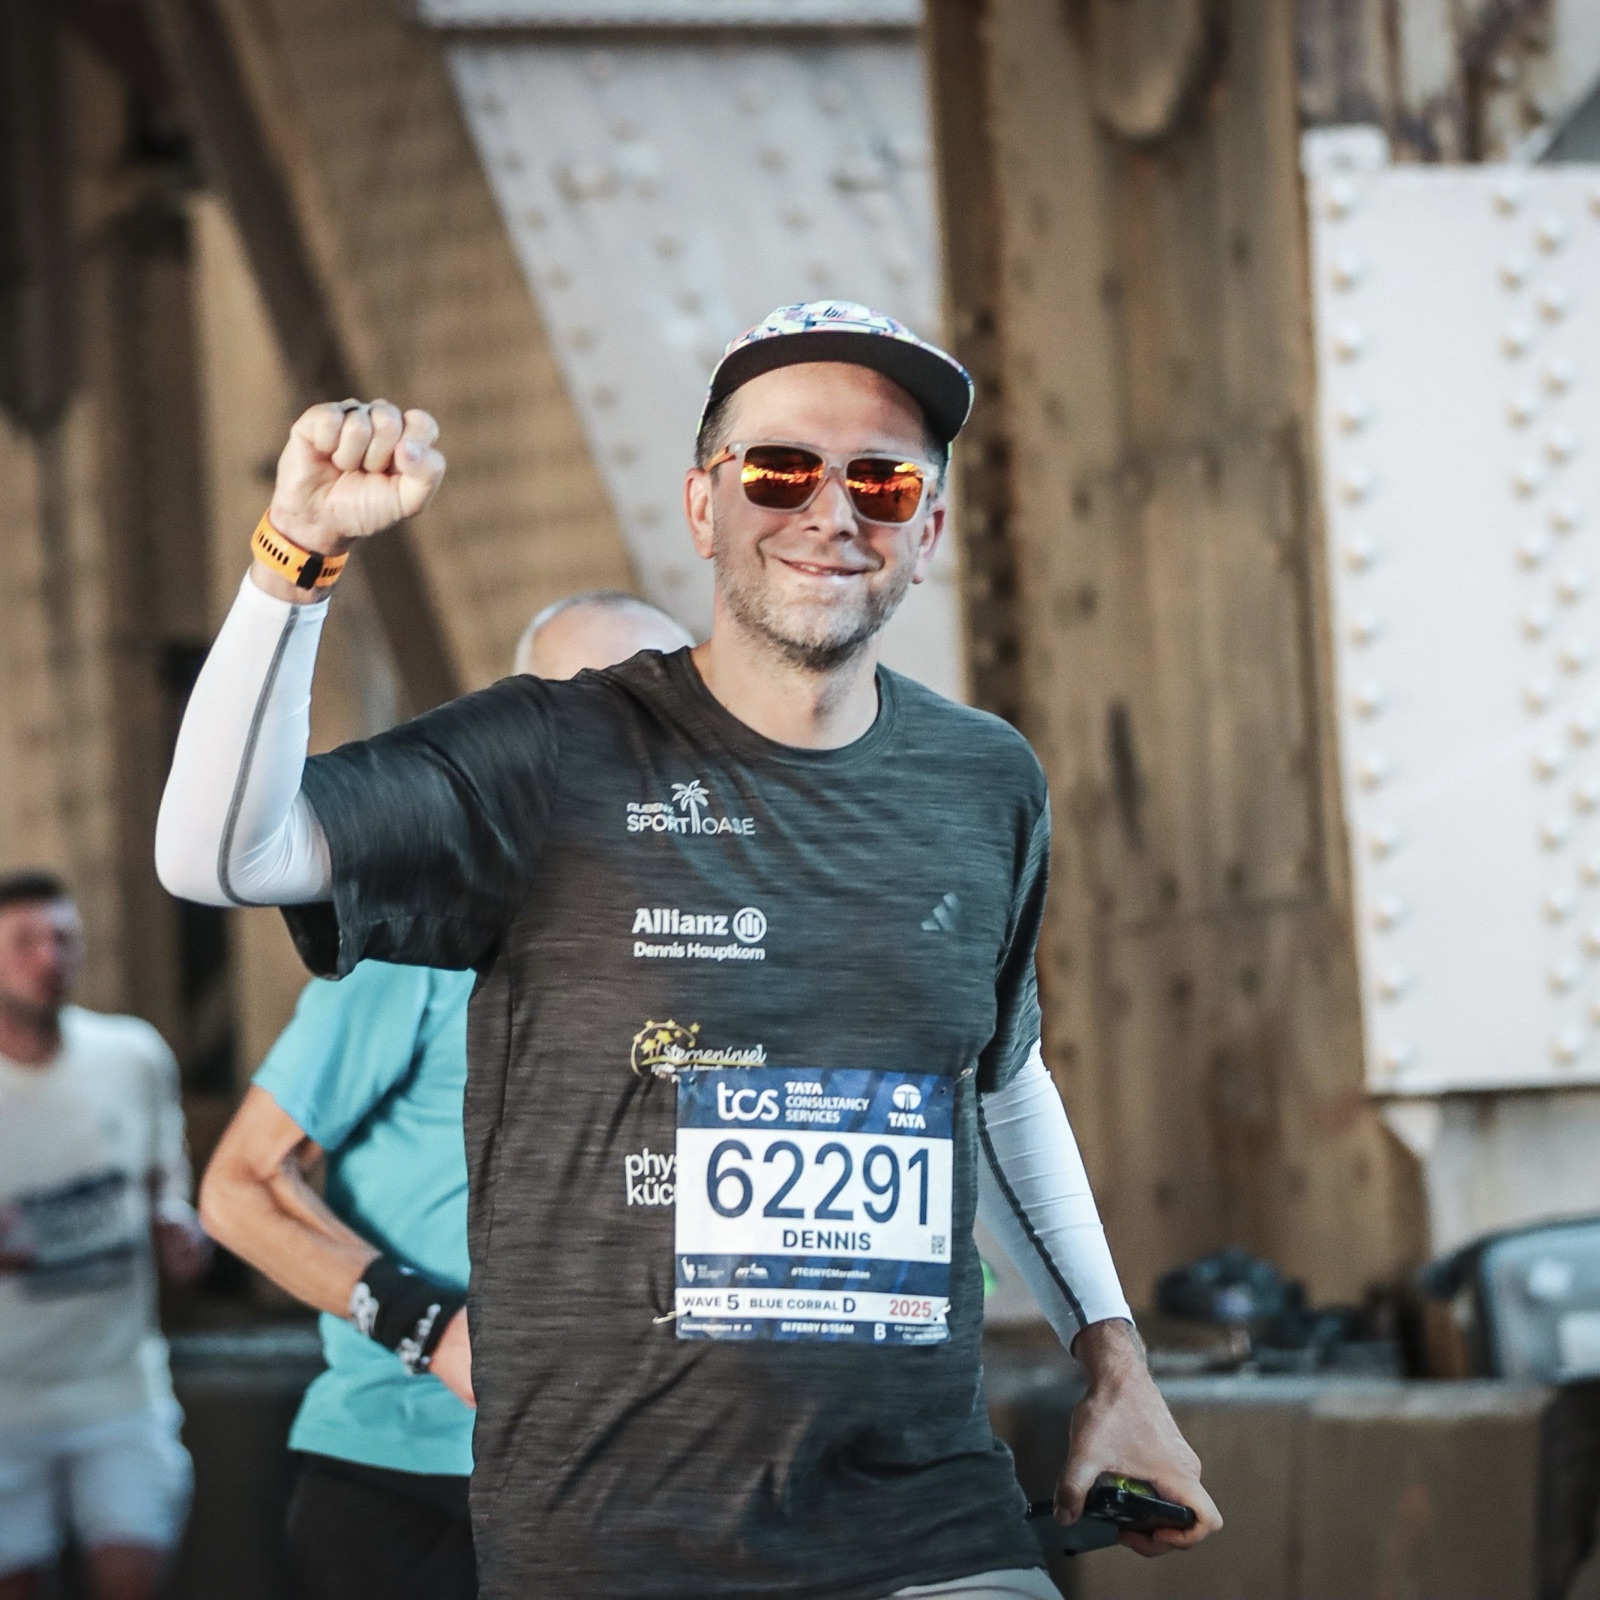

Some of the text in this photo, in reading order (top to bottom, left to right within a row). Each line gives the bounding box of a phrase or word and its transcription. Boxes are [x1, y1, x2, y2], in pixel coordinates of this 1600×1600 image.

[626, 813, 690, 834] SPORT
[632, 908, 728, 935] Allianz
[633, 941, 766, 962] Dennis Hauptkorn
[784, 1081, 823, 1096] TATA
[785, 1095, 870, 1112] CONSULTANCY
[785, 1110, 841, 1124] SERVICES
[887, 1112, 927, 1130] TATA
[626, 1176, 677, 1206] küc
[707, 1139, 929, 1226] 62291
[782, 1229, 871, 1252] DENNIS
[682, 1294, 856, 1314] WAVE 5 BLUE CORRAL D
[889, 1299, 932, 1318] 2025
[874, 1323, 886, 1341] B
